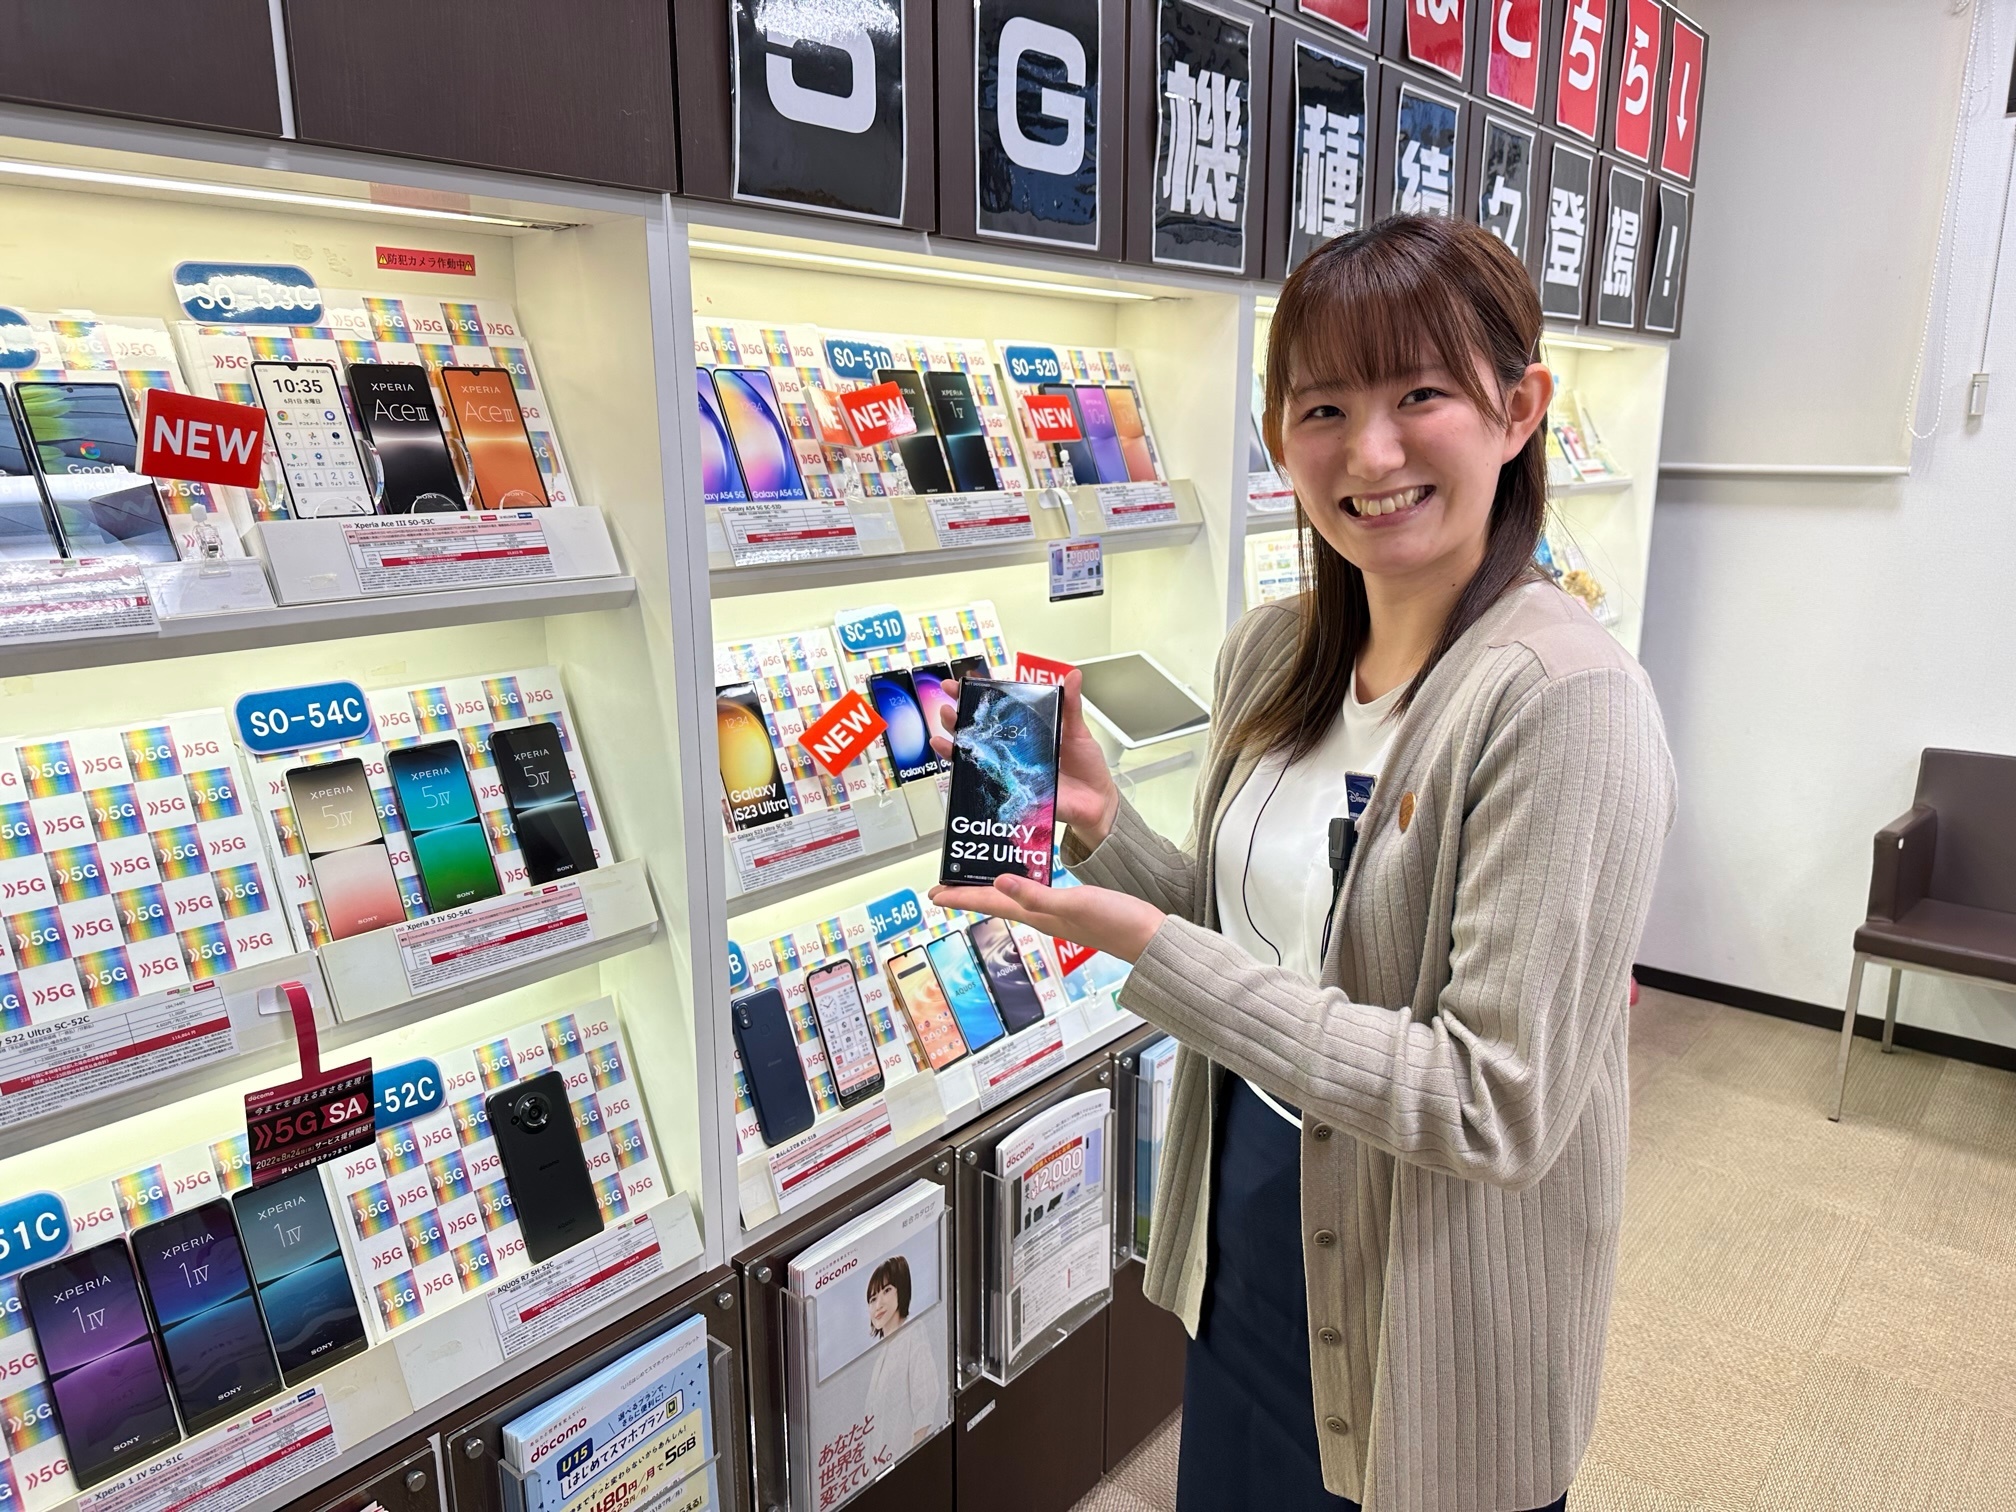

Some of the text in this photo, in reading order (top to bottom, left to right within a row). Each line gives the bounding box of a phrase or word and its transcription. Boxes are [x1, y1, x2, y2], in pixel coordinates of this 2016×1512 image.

[387, 252, 466, 270] 防犯カメラ作動中
[383, 315, 405, 328] 5G
[721, 341, 735, 352] 5G
[833, 346, 892, 370] SO-51D
[1012, 359, 1059, 377] SO-52D
[272, 379, 323, 395] 10:35
[371, 382, 415, 393] XPERIA
[461, 385, 502, 395] XPERIA
[785, 382, 799, 392] 5G
[941, 389, 963, 397] XPERIA
[374, 399, 415, 422] Ace
[463, 400, 502, 423] Ace
[851, 396, 907, 432] NEW
[1031, 407, 1075, 429] NEW
[796, 416, 809, 426] 5G
[153, 416, 258, 465] NEW
[720, 491, 733, 499] A54
[735, 491, 745, 499] 5G
[752, 488, 803, 501] Galaxy A54 5G
[354, 521, 379, 529] Xperia
[396, 519, 407, 527] III
[408, 518, 436, 526] SO-53C
[845, 617, 901, 643] SC-51D
[768, 656, 781, 667] 5G
[792, 650, 804, 661] 5G
[816, 648, 828, 659] 5G
[778, 686, 791, 698] 5G
[802, 683, 815, 695] 5G
[824, 679, 837, 690] 5G
[428, 702, 448, 718] 5G
[465, 699, 485, 713] 5G
[250, 697, 363, 737] SO-54C
[389, 711, 411, 727] 5G
[725, 715, 749, 729] 12:34
[788, 724, 801, 735] 5G
[813, 701, 873, 764] NEW
[146, 745, 172, 761] 5G
[195, 741, 220, 756] 5G
[513, 747, 550, 762] XPERIA
[41, 760, 70, 777] 5G
[96, 756, 123, 772] 5G
[798, 754, 811, 767] 5G
[411, 766, 451, 781] XPERIA
[524, 765, 539, 788] 5
[900, 760, 938, 779] Galaxy S23
[207, 786, 232, 802] 5G
[310, 784, 354, 800] XPERIA
[422, 786, 438, 809] 5
[730, 782, 777, 803] Galaxy
[808, 791, 822, 803] 5G
[832, 784, 845, 796] 5G
[109, 803, 137, 819] 5G
[160, 797, 186, 813] 5G
[735, 798, 789, 821] S23 Ultra
[57, 815, 86, 833] 5G
[322, 805, 339, 829] 5
[951, 815, 1037, 840] Galaxy
[173, 843, 200, 859] 5G
[222, 836, 247, 852] 5G
[949, 840, 990, 861] S22
[993, 842, 1048, 866] Ultra
[72, 864, 99, 882] 5G
[125, 856, 151, 873] 5G
[556, 863, 575, 873] SONY
[18, 878, 46, 896] 5G
[236, 882, 260, 898] 5G
[456, 889, 476, 899] SONY
[188, 895, 214, 911] 5G
[357, 914, 378, 925] SONY
[406, 908, 474, 931] Xperia IV SO-54C
[871, 901, 918, 936] SH-54B
[996, 963, 1017, 978] AQUOS
[955, 981, 976, 997] AQUOS
[801, 1013, 814, 1027] 5G
[4, 1015, 91, 1046] S22 Ultra SC-52C
[592, 1021, 609, 1037] 5G
[558, 1030, 576, 1047] 5G
[527, 1046, 545, 1061] 5G
[812, 1053, 824, 1066] 5G
[492, 1055, 510, 1072] 5G
[602, 1058, 619, 1074] 5G
[459, 1071, 476, 1087] 5G
[571, 1072, 588, 1089] 5G
[248, 1090, 275, 1102] docomo
[254, 1075, 366, 1116] 今までを超える速さを実現!
[613, 1099, 630, 1115] 5G
[274, 1096, 363, 1144] 5G SA
[581, 1109, 599, 1126] 5G
[315, 1123, 373, 1150] サービス提供開始!
[623, 1136, 641, 1153] 5G
[281, 1144, 352, 1175] 詳しくは店頭スタッフまで!
[594, 1151, 611, 1167] 5G
[1006, 1142, 1035, 1168] docomo
[1030, 1147, 1083, 1200] ¥12,000
[258, 1195, 306, 1220] XPERIA
[902, 1201, 936, 1229] 総合カタログ
[85, 1207, 114, 1227] 5G
[162, 1233, 215, 1260] XPERIA
[498, 1260, 555, 1294] AQUOS R7 SH-52C
[815, 1258, 858, 1290] docomo
[54, 1275, 112, 1304] XPERIA
[311, 1340, 334, 1355] SONY
[9, 1354, 38, 1375] 5G
[217, 1385, 243, 1401] SONY
[617, 1383, 667, 1423] 選べるプランで、
[621, 1393, 665, 1427] さらに便利に!
[113, 1434, 141, 1452] SONY
[530, 1417, 587, 1464] docomo
[818, 1415, 875, 1468] あなたと
[561, 1444, 589, 1473] U15
[567, 1411, 666, 1490] はじめてスマホプラン
[818, 1441, 866, 1490] 世界を
[94, 1452, 184, 1502] Xperia IV SO-51C
[820, 1444, 893, 1512] 変えていく。
